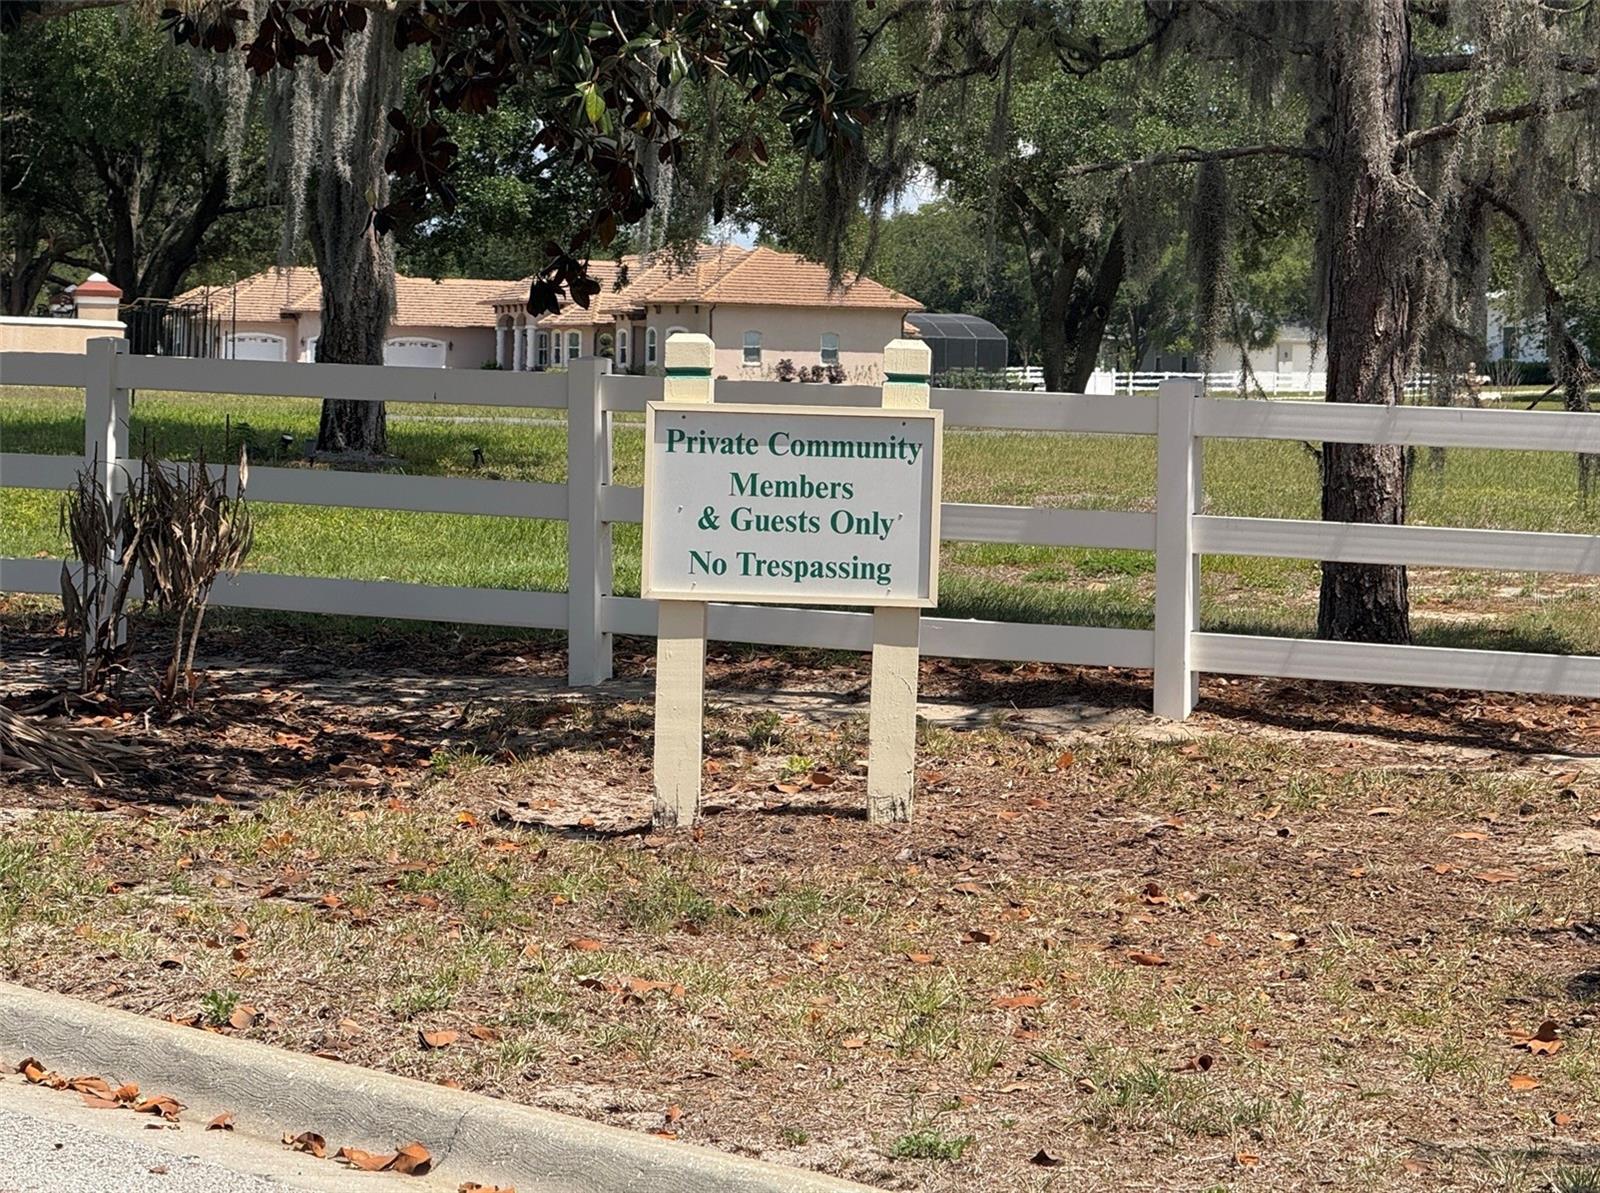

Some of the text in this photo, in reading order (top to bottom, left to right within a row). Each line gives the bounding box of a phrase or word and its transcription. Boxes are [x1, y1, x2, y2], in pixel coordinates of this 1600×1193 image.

[666, 428, 923, 465] Private Community
[729, 472, 854, 500] Members
[698, 506, 894, 541] & Guests Only
[688, 550, 892, 585] No Trespassing
